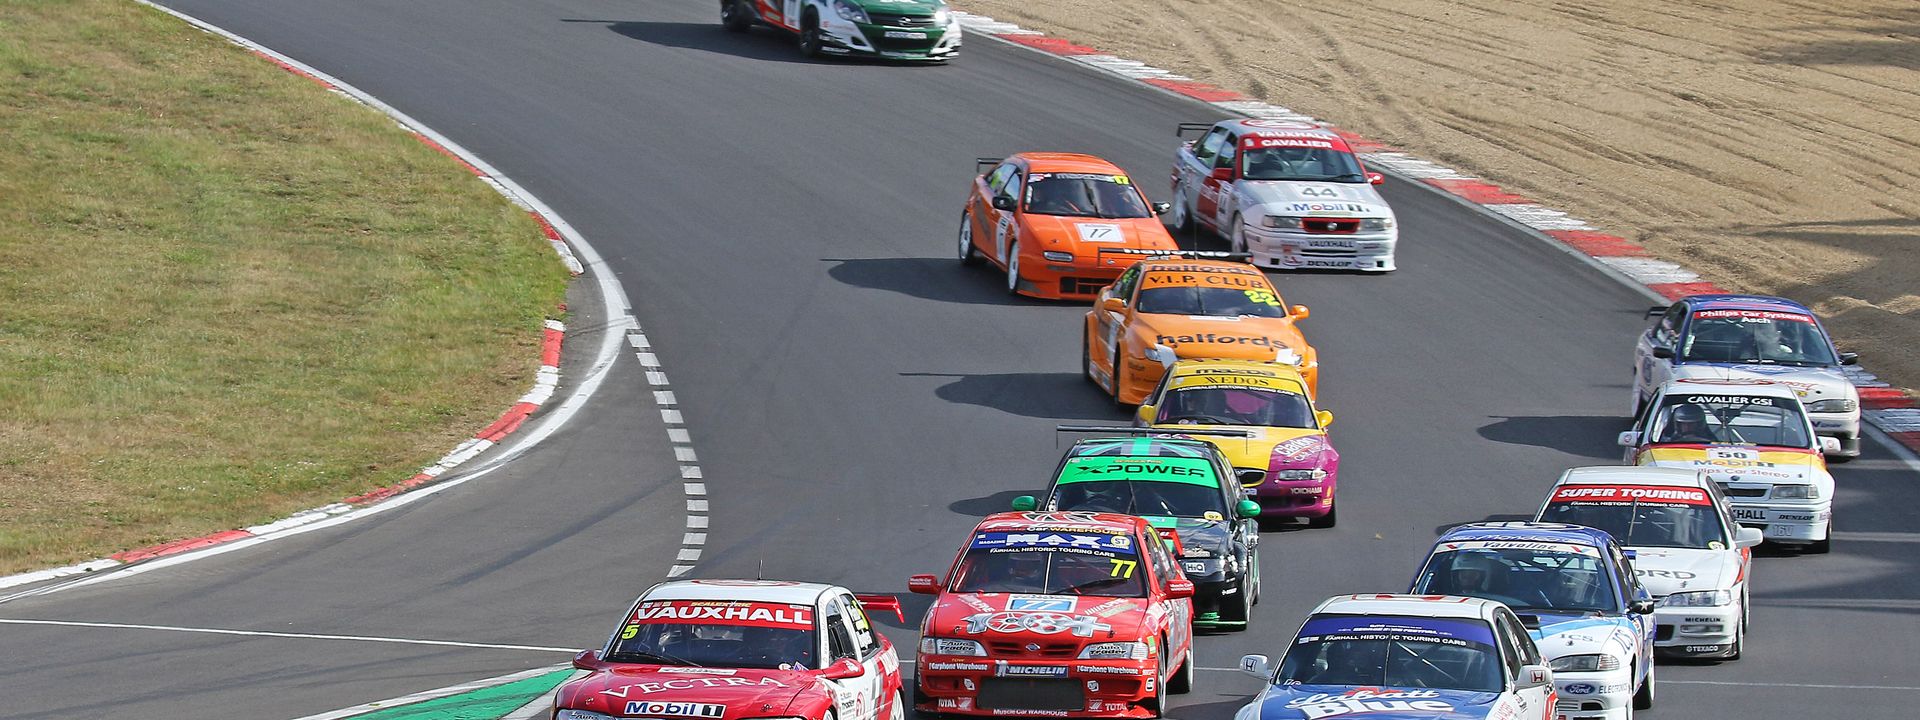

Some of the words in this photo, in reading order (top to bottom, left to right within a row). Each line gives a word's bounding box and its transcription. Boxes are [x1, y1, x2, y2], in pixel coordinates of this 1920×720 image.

[1256, 131, 1333, 140] VAUXHALL
[1261, 139, 1333, 148] CAVALIER
[1302, 187, 1338, 198] 44
[1292, 203, 1345, 212] Mobil
[1090, 229, 1112, 239] 17
[1150, 275, 1197, 284] V.I.P.
[1206, 275, 1265, 289] CLUB
[1244, 290, 1281, 307] 22
[1762, 312, 1809, 322] Systems
[1156, 332, 1290, 350] halfords
[1203, 376, 1270, 387] XEDOS
[1687, 396, 1749, 405] CAVALIER
[1717, 451, 1748, 459] 50
[1750, 470, 1791, 479] Stereo
[1291, 486, 1323, 495] YOKOHAMA
[1558, 488, 1616, 498] SUPER
[1621, 488, 1704, 501] TOURING
[1050, 528, 1126, 536] WAREHOUSE
[1773, 525, 1795, 537] 16V
[1005, 534, 1102, 549] MAX
[1114, 536, 1127, 545] ST
[1482, 541, 1558, 550] Valvoline
[1058, 547, 1094, 555] TOURING
[1094, 550, 1116, 558] CARS
[1110, 558, 1137, 579] 77
[1018, 601, 1072, 609] 77
[637, 607, 812, 625] VAUXHALL
[621, 625, 641, 640] 5
[1401, 635, 1441, 644] TOURING
[1442, 638, 1467, 647] CARS
[1693, 645, 1719, 653] TEXACO
[1008, 665, 1066, 675] MICHELIN
[599, 676, 789, 698] VECTRA
[938, 699, 957, 708] TOTAL
[625, 702, 696, 716] Mobil
[1302, 700, 1459, 720] Blue
